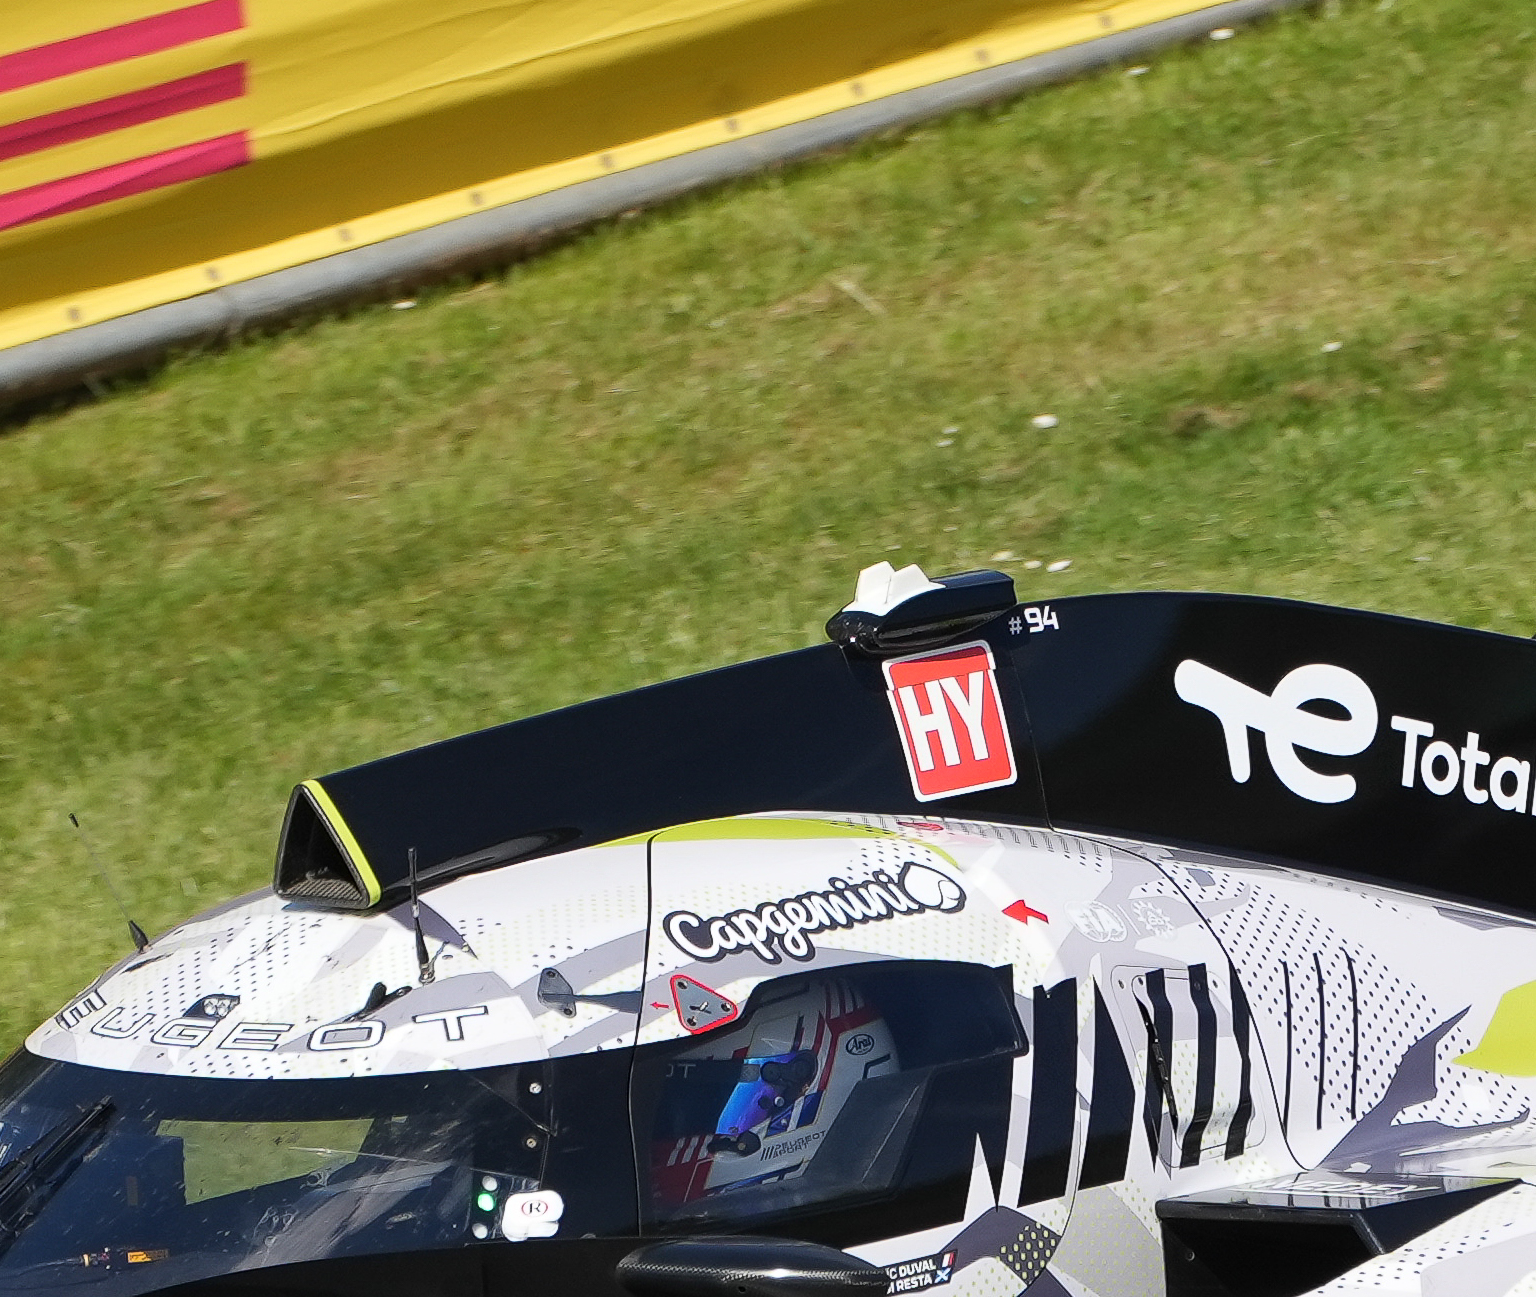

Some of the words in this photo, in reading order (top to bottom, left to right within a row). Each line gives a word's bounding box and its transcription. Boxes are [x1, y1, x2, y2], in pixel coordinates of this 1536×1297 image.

[898, 670, 990, 772] HY
[665, 868, 919, 962] Capgemini
[53, 988, 488, 1052] EUGEOT
[896, 1273, 933, 1292] RESTA
[899, 1259, 937, 1278] DUVAL
